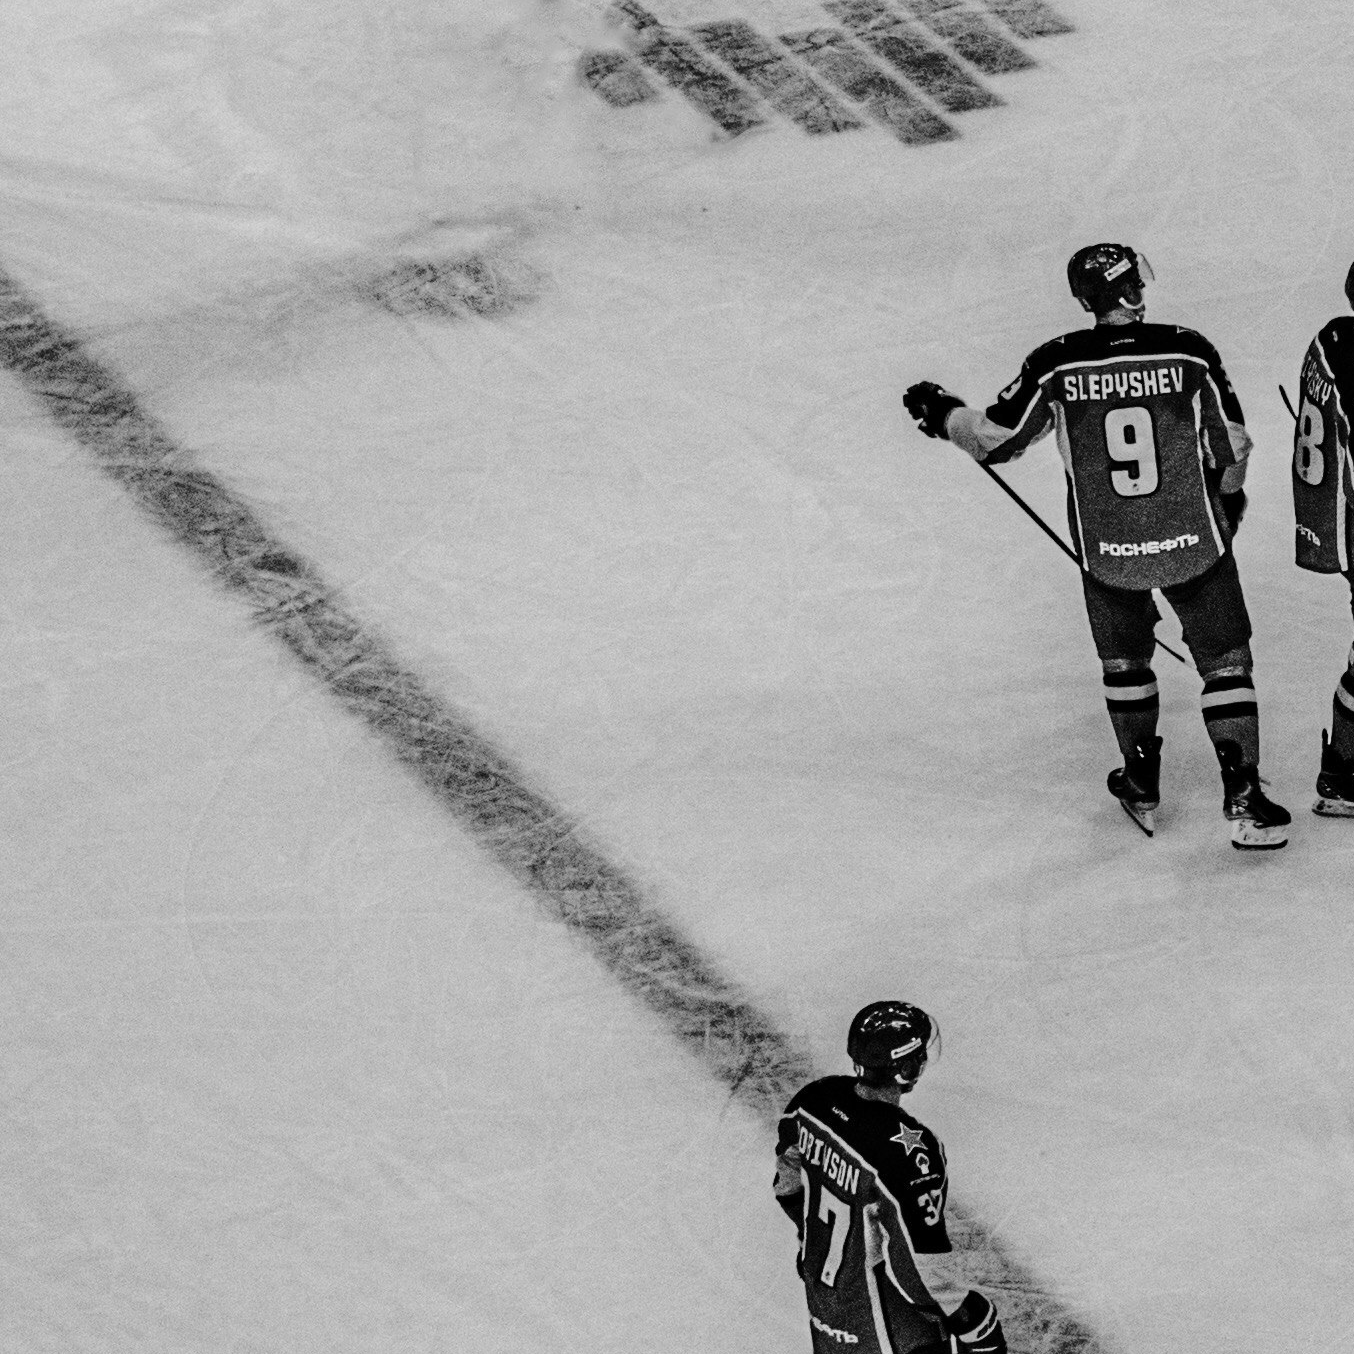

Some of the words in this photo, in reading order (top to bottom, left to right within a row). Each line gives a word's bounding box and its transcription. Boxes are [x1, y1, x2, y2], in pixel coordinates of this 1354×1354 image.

[1063, 367, 1183, 401] SLEPYSHEV
[1104, 406, 1159, 497] 9
[1099, 534, 1199, 557] РОСНЕФТЬ
